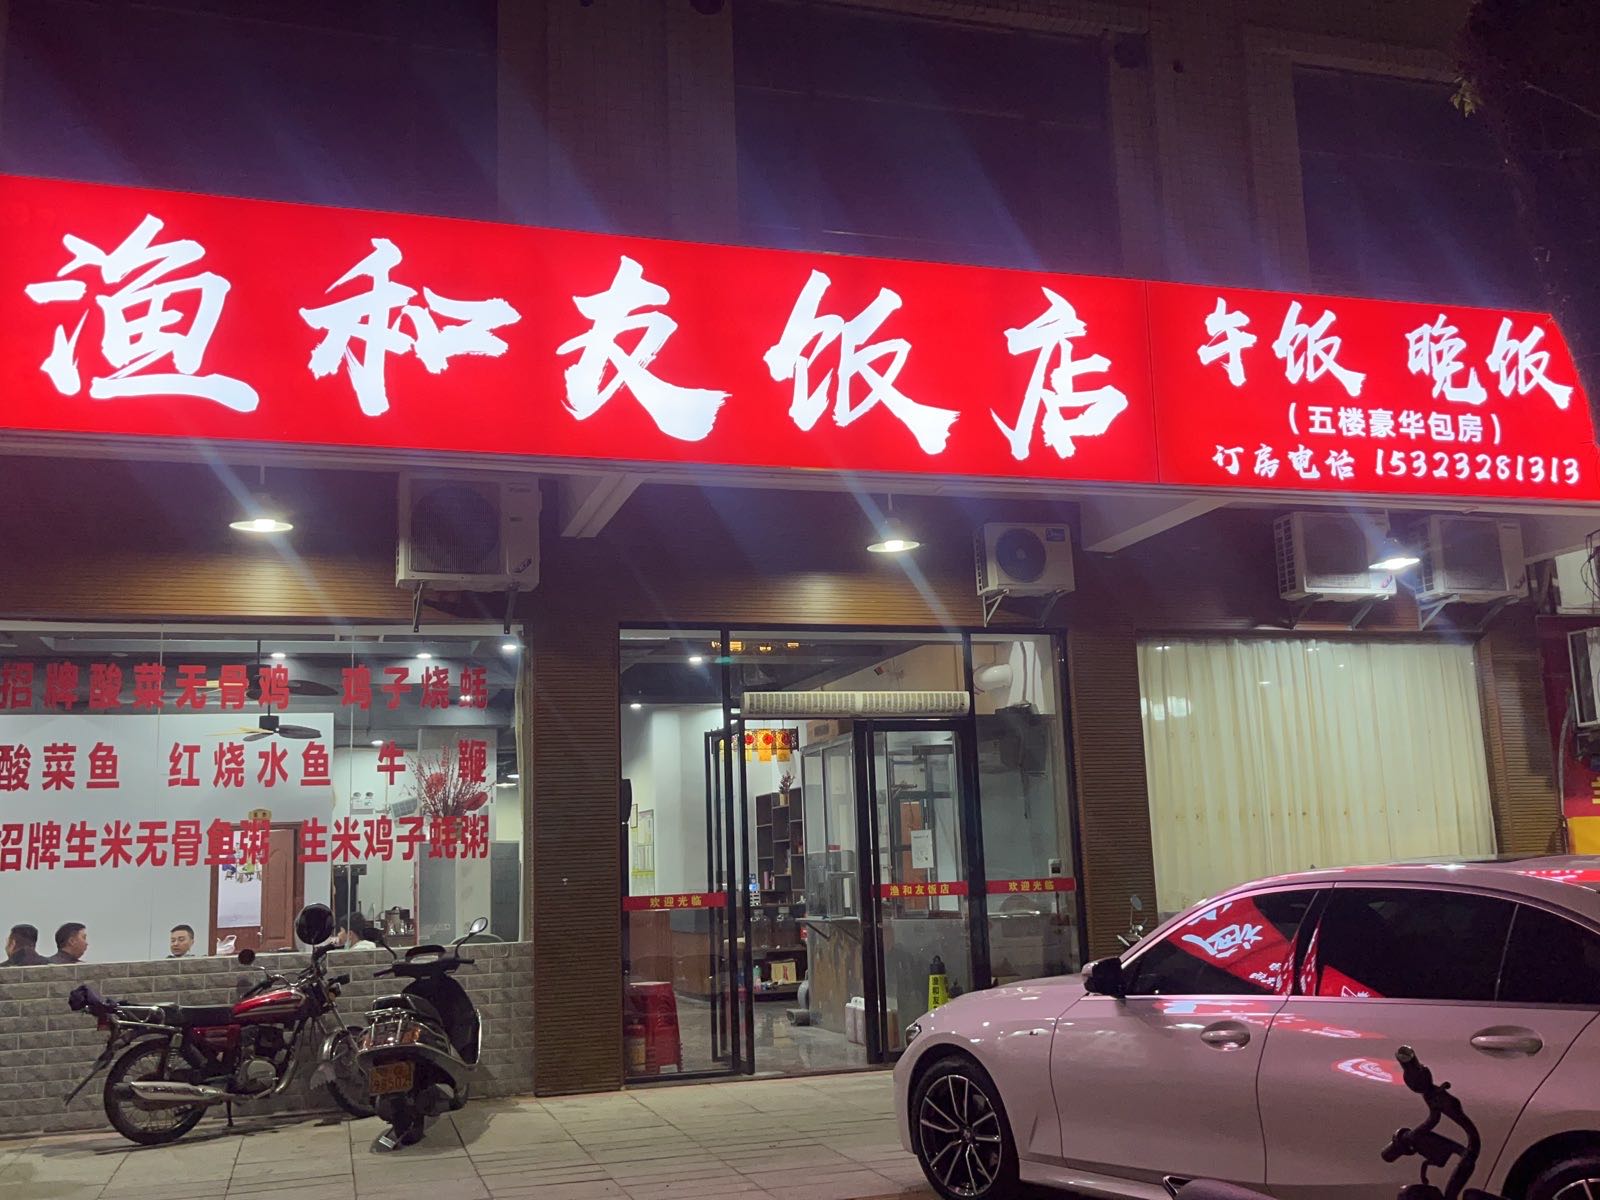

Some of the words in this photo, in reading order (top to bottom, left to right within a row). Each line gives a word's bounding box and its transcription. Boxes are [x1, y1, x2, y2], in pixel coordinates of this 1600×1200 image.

[25, 213, 1129, 462] 渔和友饭店
[1197, 297, 1366, 397] 午饭
[1404, 313, 1573, 411] 晚饭
[1211, 443, 1356, 481] 订房电话
[1374, 448, 1581, 485] 15323281313
[0, 662, 290, 710] 招牌酸菜无骨鸡
[341, 664, 488, 710] 鸡子烧蚝
[0, 742, 120, 792] 酸菜鱼
[168, 740, 331, 788] 红烧水鱼
[299, 814, 489, 864] 生米鸡子蚝粥
[649, 895, 702, 908] 欢迎光临
[890, 883, 950, 896] 渔和友饭店
[1008, 880, 1055, 892] 欢迎光临
